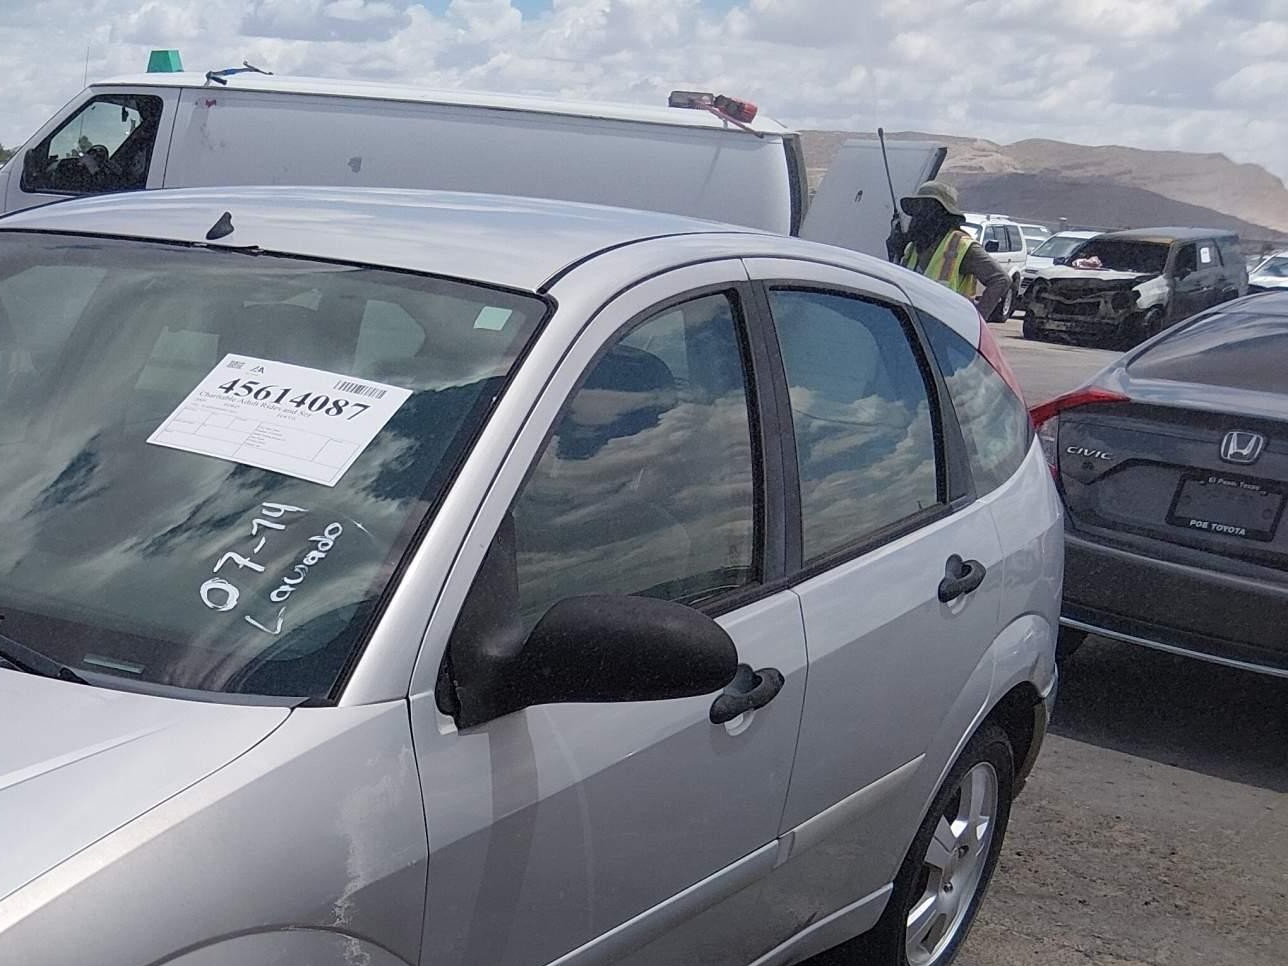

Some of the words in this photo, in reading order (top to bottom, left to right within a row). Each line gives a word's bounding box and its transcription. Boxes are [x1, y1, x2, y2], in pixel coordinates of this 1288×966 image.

[219, 378, 371, 420] 45614087
[1066, 446, 1113, 460] CIVIC
[1211, 523, 1247, 536] TOYOTA
[199, 501, 310, 612] 07-14
